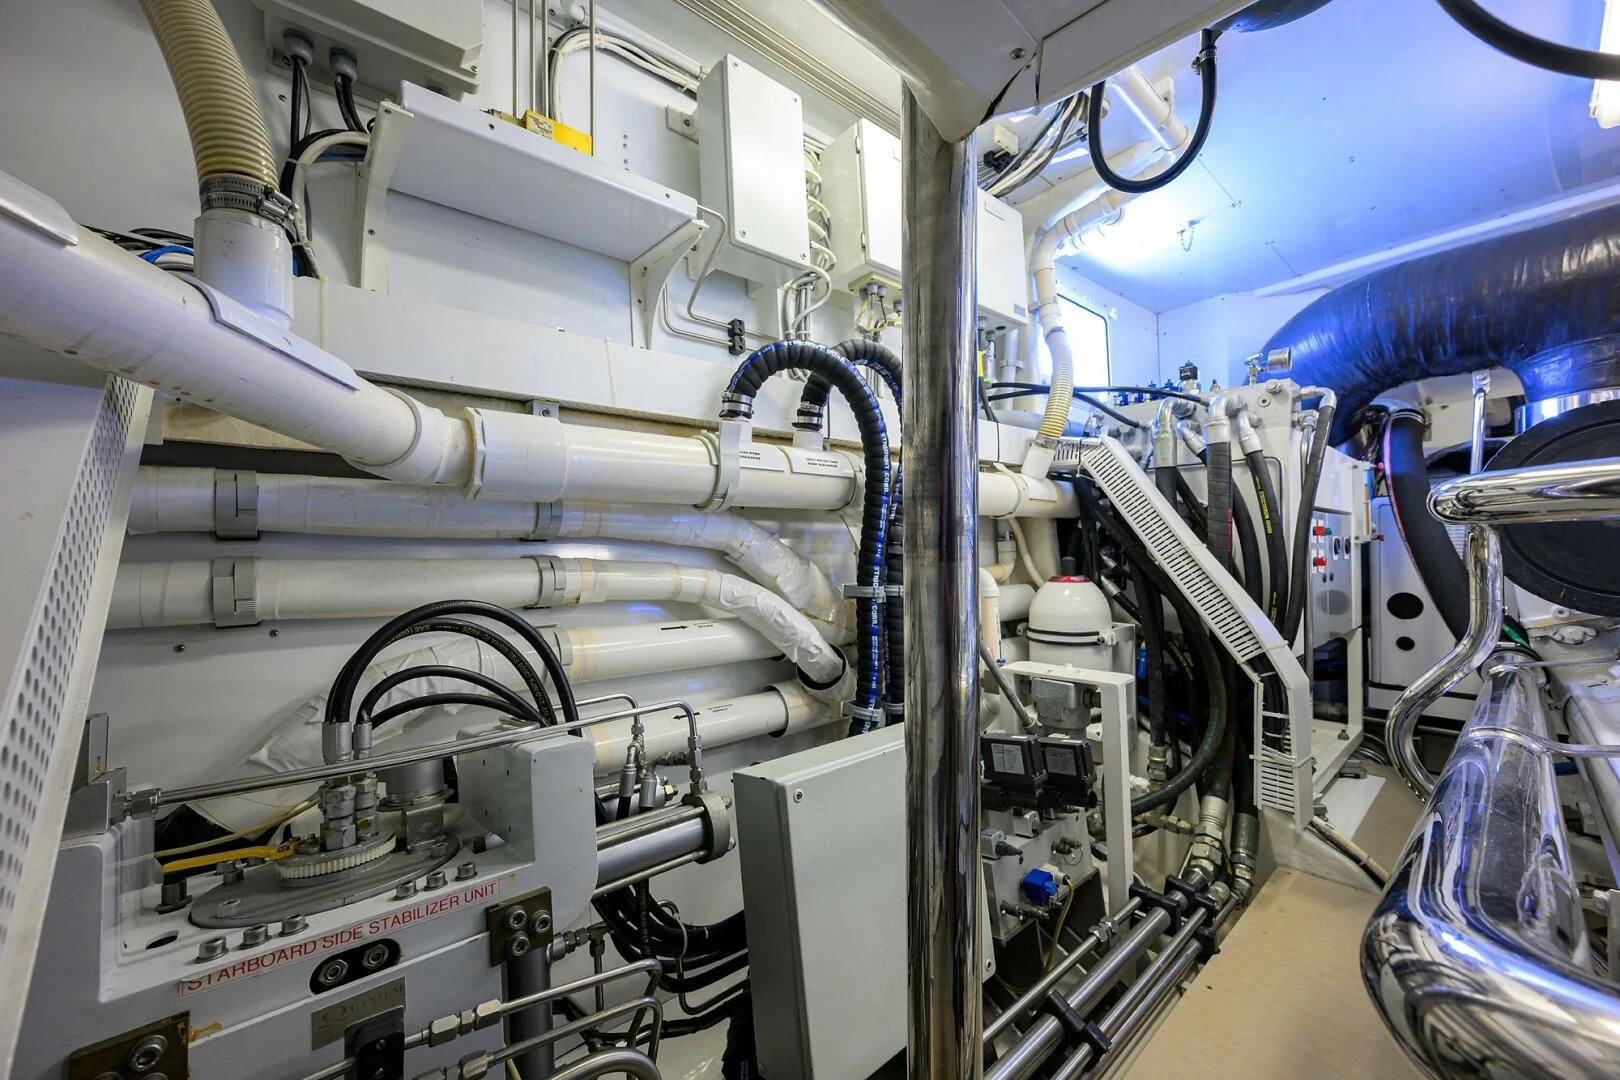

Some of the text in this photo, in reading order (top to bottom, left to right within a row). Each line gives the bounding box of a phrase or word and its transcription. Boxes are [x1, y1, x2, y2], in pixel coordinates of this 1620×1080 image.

[881, 438, 890, 469] TRIDENT
[187, 882, 498, 991] STARBOARD SIDE STABILIZER UNIT
